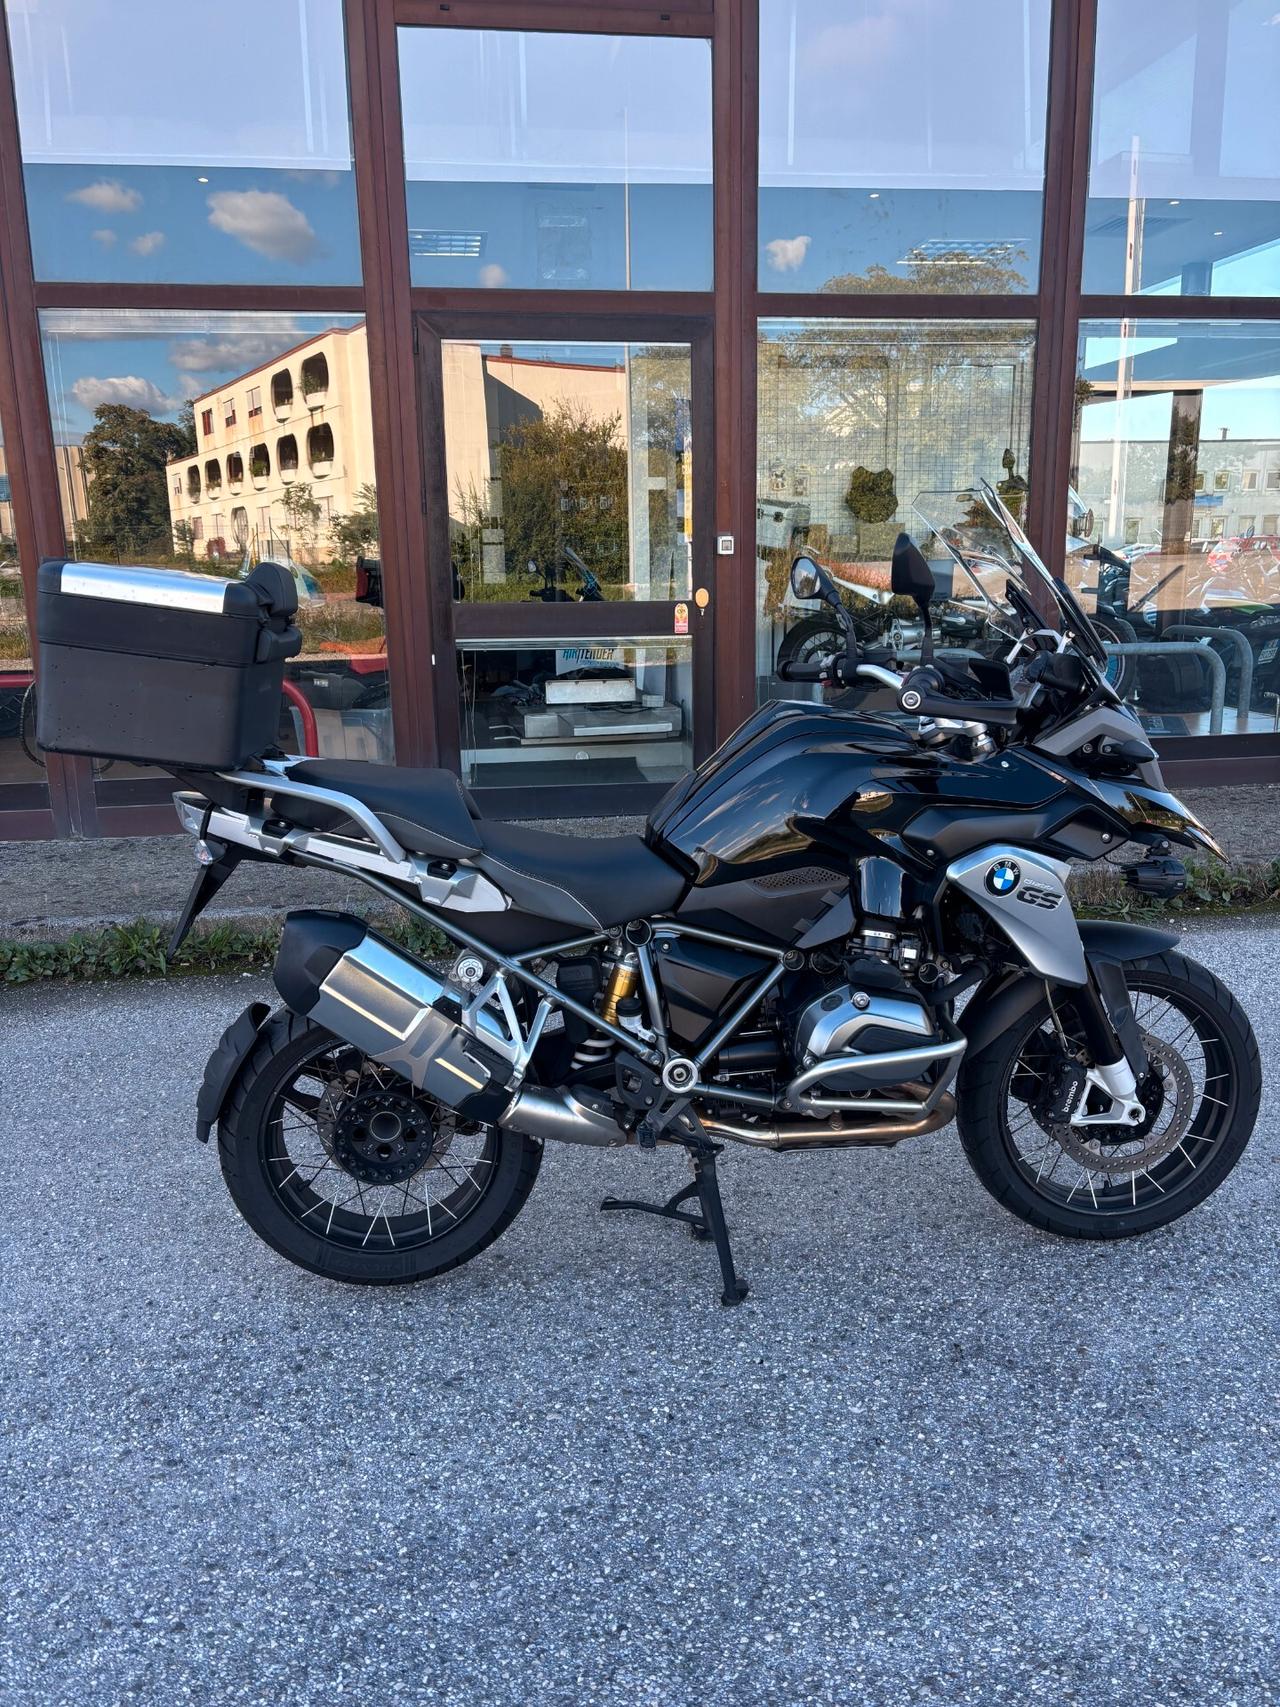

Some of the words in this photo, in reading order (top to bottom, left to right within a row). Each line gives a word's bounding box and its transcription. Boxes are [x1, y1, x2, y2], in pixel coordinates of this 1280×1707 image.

[993, 861, 1020, 876] BMW
[1016, 886, 1063, 910] GS
[1061, 1080, 1079, 1113] brembo
